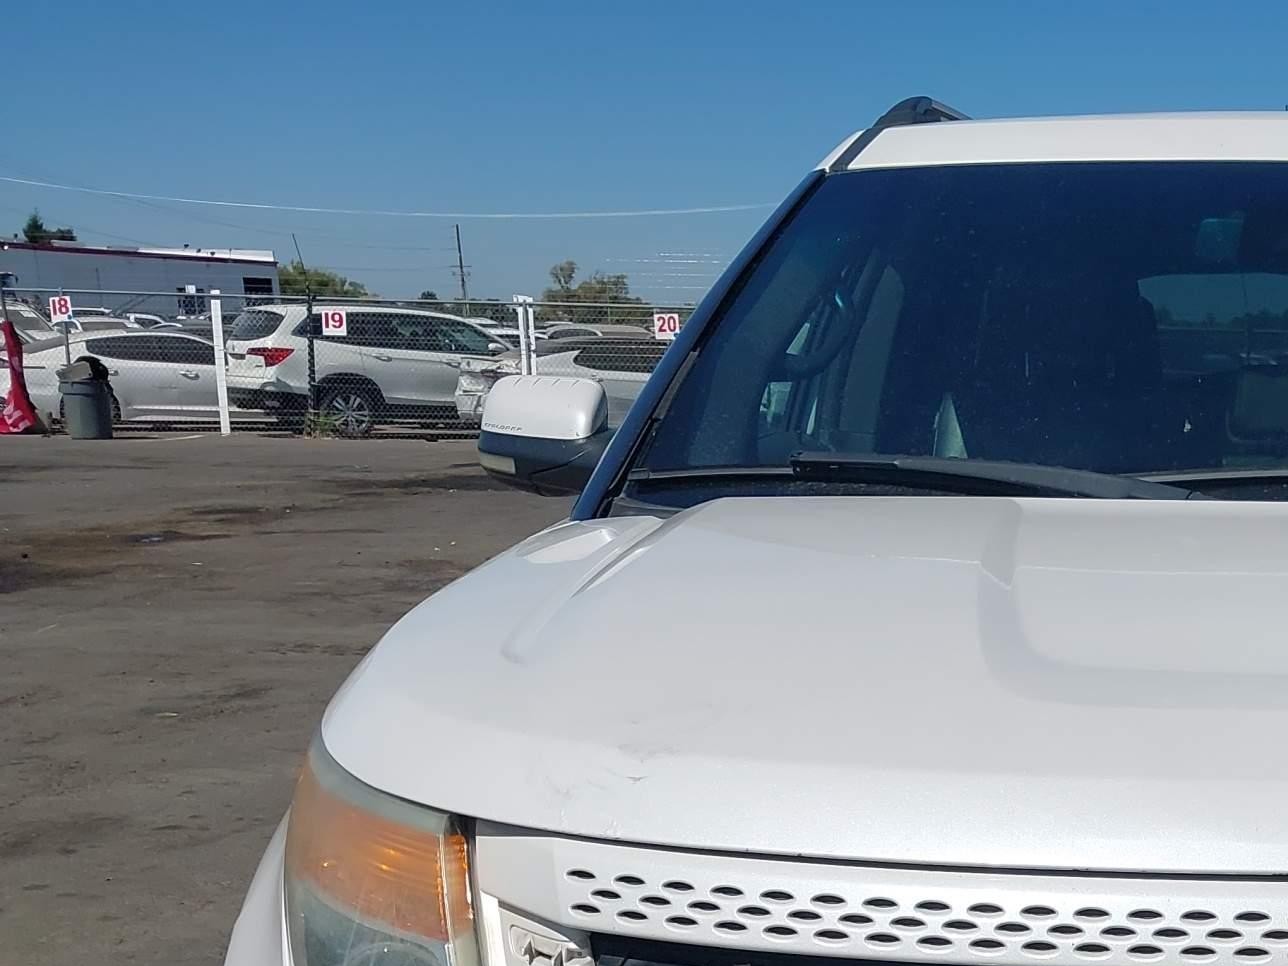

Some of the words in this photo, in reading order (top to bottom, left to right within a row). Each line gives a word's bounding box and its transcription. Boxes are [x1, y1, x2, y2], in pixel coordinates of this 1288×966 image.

[52, 297, 70, 316] 18
[324, 311, 344, 329] 19
[656, 315, 677, 332] 20
